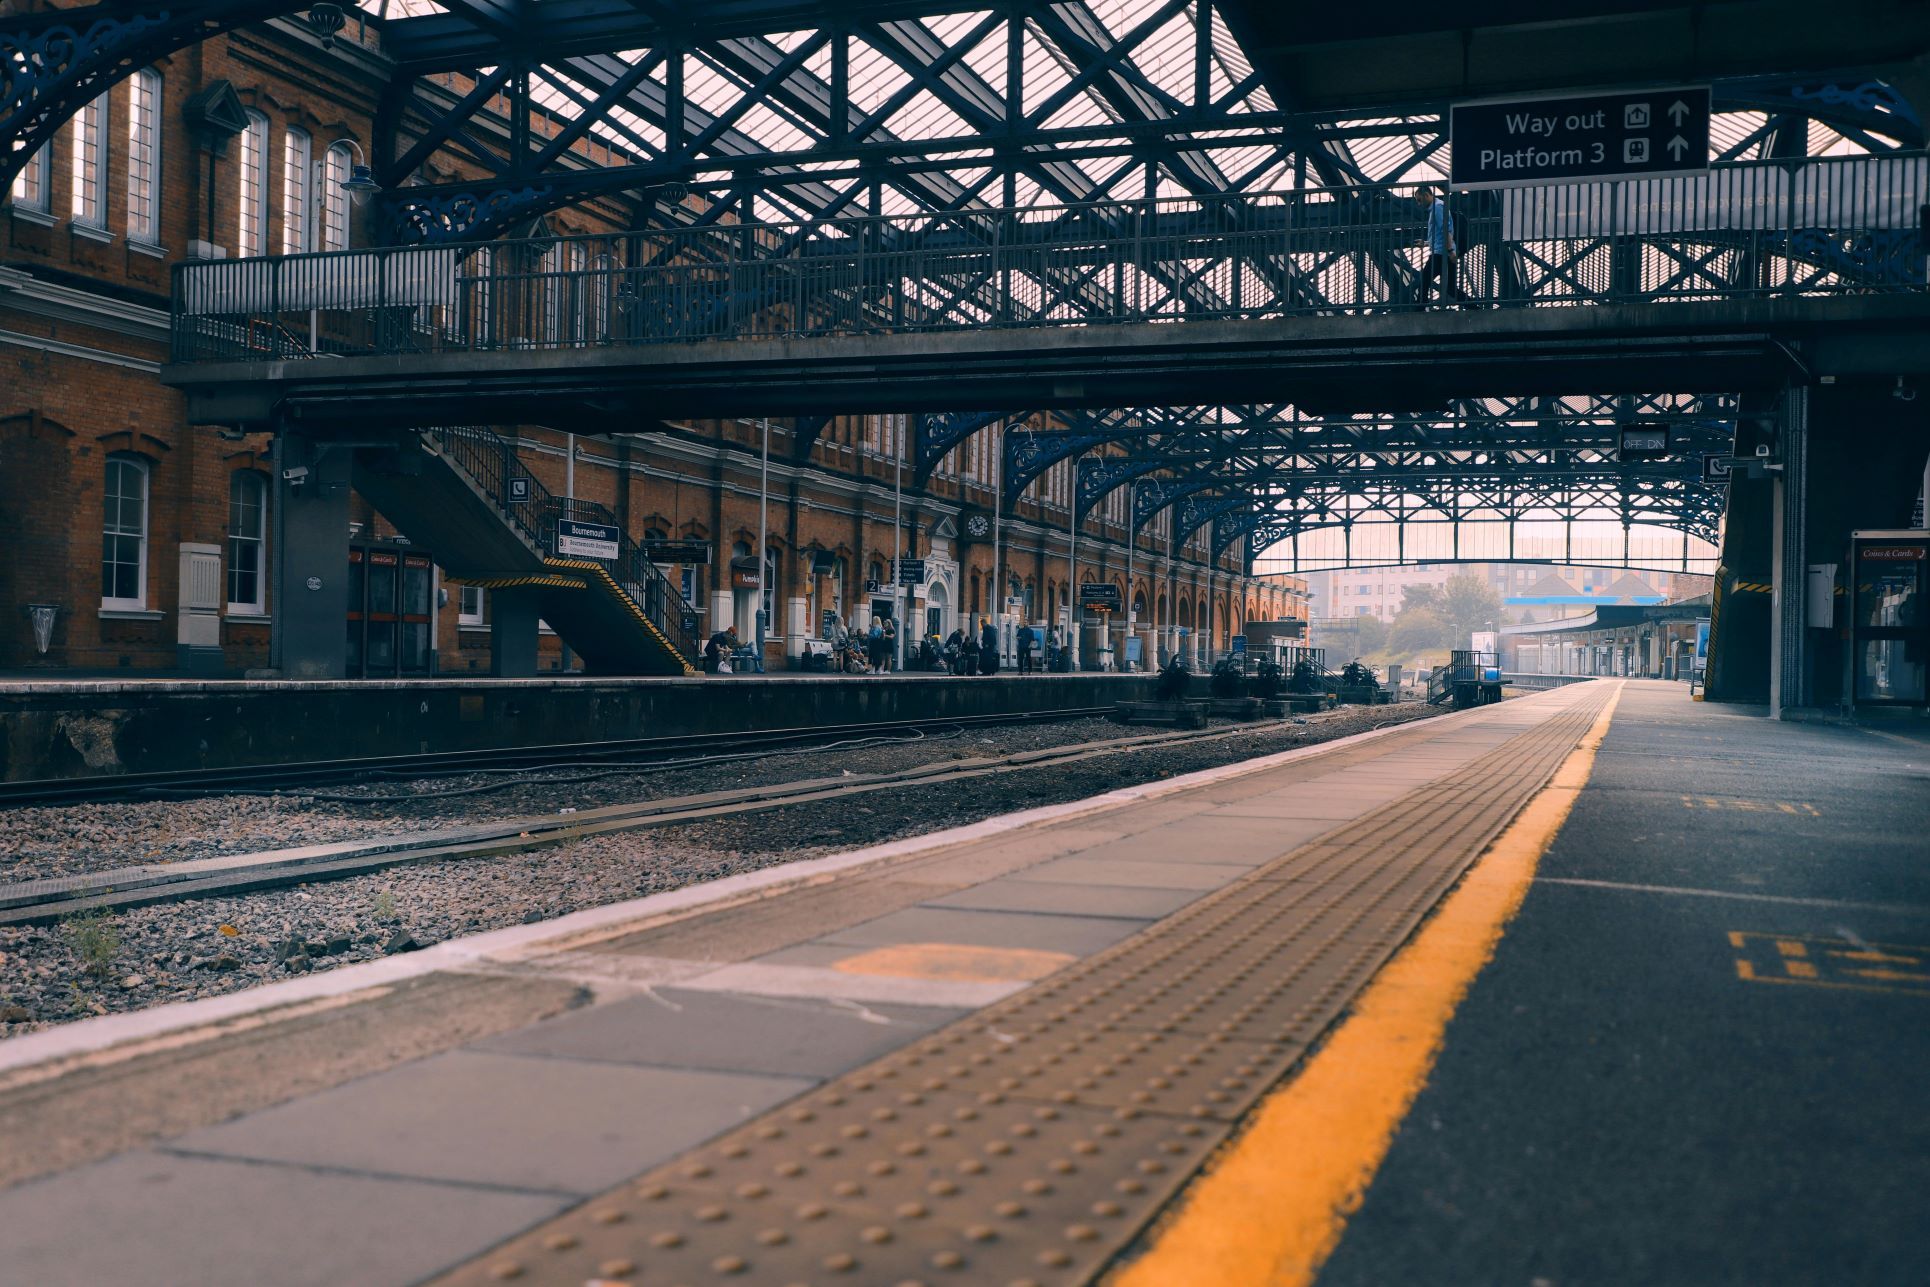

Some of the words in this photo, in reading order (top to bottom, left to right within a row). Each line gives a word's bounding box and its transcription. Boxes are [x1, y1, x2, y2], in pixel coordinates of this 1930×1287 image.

[1505, 113, 1558, 137] Way
[1566, 110, 1606, 130] out
[1480, 146, 1583, 170] Platform
[1590, 142, 1605, 163] 3
[571, 525, 607, 538] Bournemouth
[1863, 549, 1884, 557] Coins
[1892, 549, 1913, 557] Cards
[869, 581, 876, 591] 2
